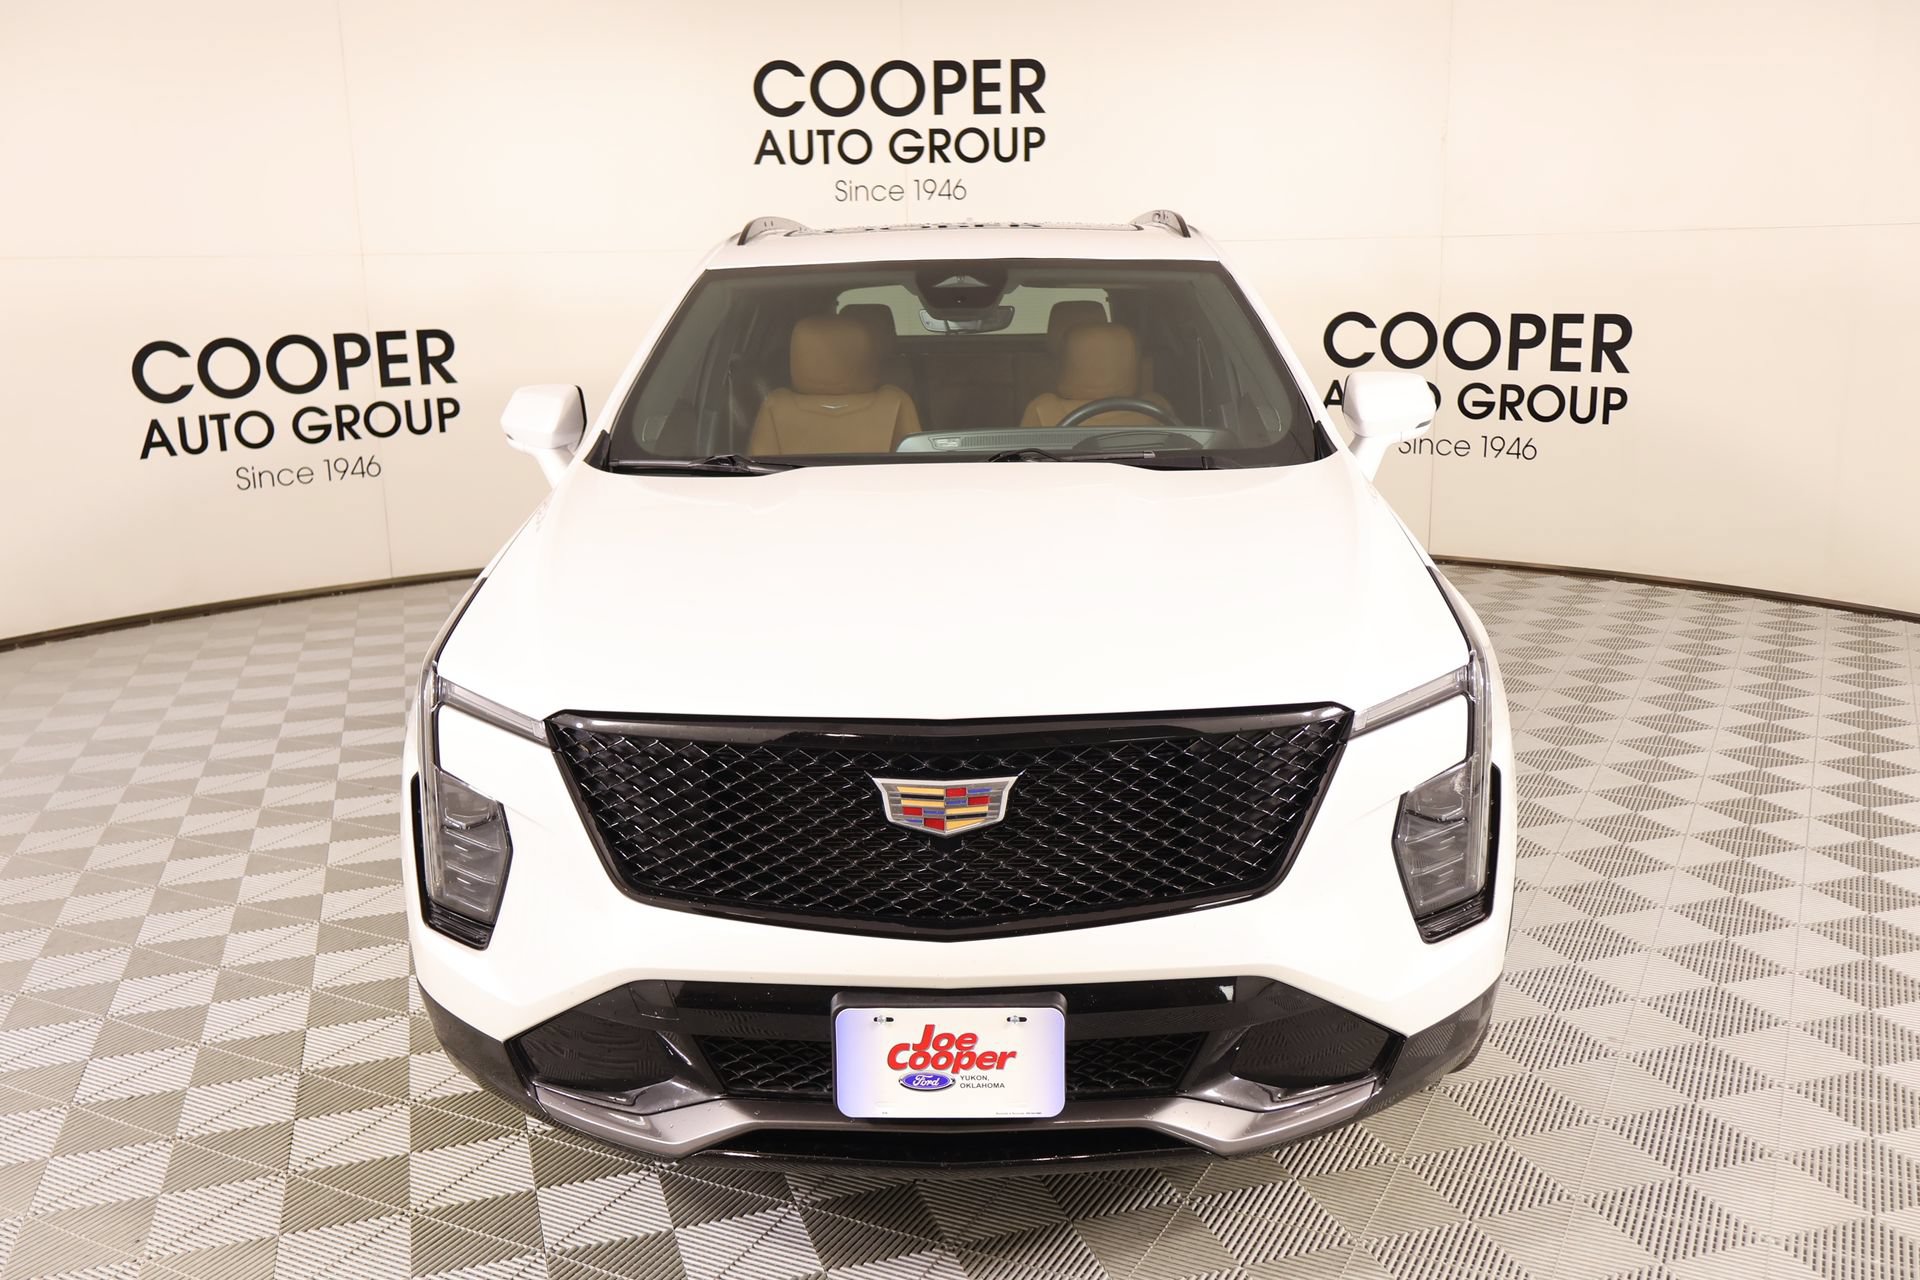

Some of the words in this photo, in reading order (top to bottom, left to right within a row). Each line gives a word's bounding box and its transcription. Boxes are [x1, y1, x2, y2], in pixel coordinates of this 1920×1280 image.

[753, 59, 1046, 118] COOPER
[753, 129, 873, 165] AUTO
[888, 126, 1046, 164] GROUP
[834, 179, 905, 203] Since
[913, 178, 967, 201] 1946
[1323, 311, 1633, 374] COOPER
[131, 328, 458, 405] COOPER
[1457, 382, 1628, 425] GROUP
[139, 410, 275, 460] AUTO
[291, 396, 461, 445] GROUP
[1480, 435, 1538, 461] 1946
[235, 465, 315, 491] Since
[323, 454, 382, 482] 1946
[912, 1023, 978, 1052] Joe
[886, 1042, 1017, 1074] Cooper
[912, 1074, 940, 1087] Ford
[959, 1074, 990, 1082] YUKON,
